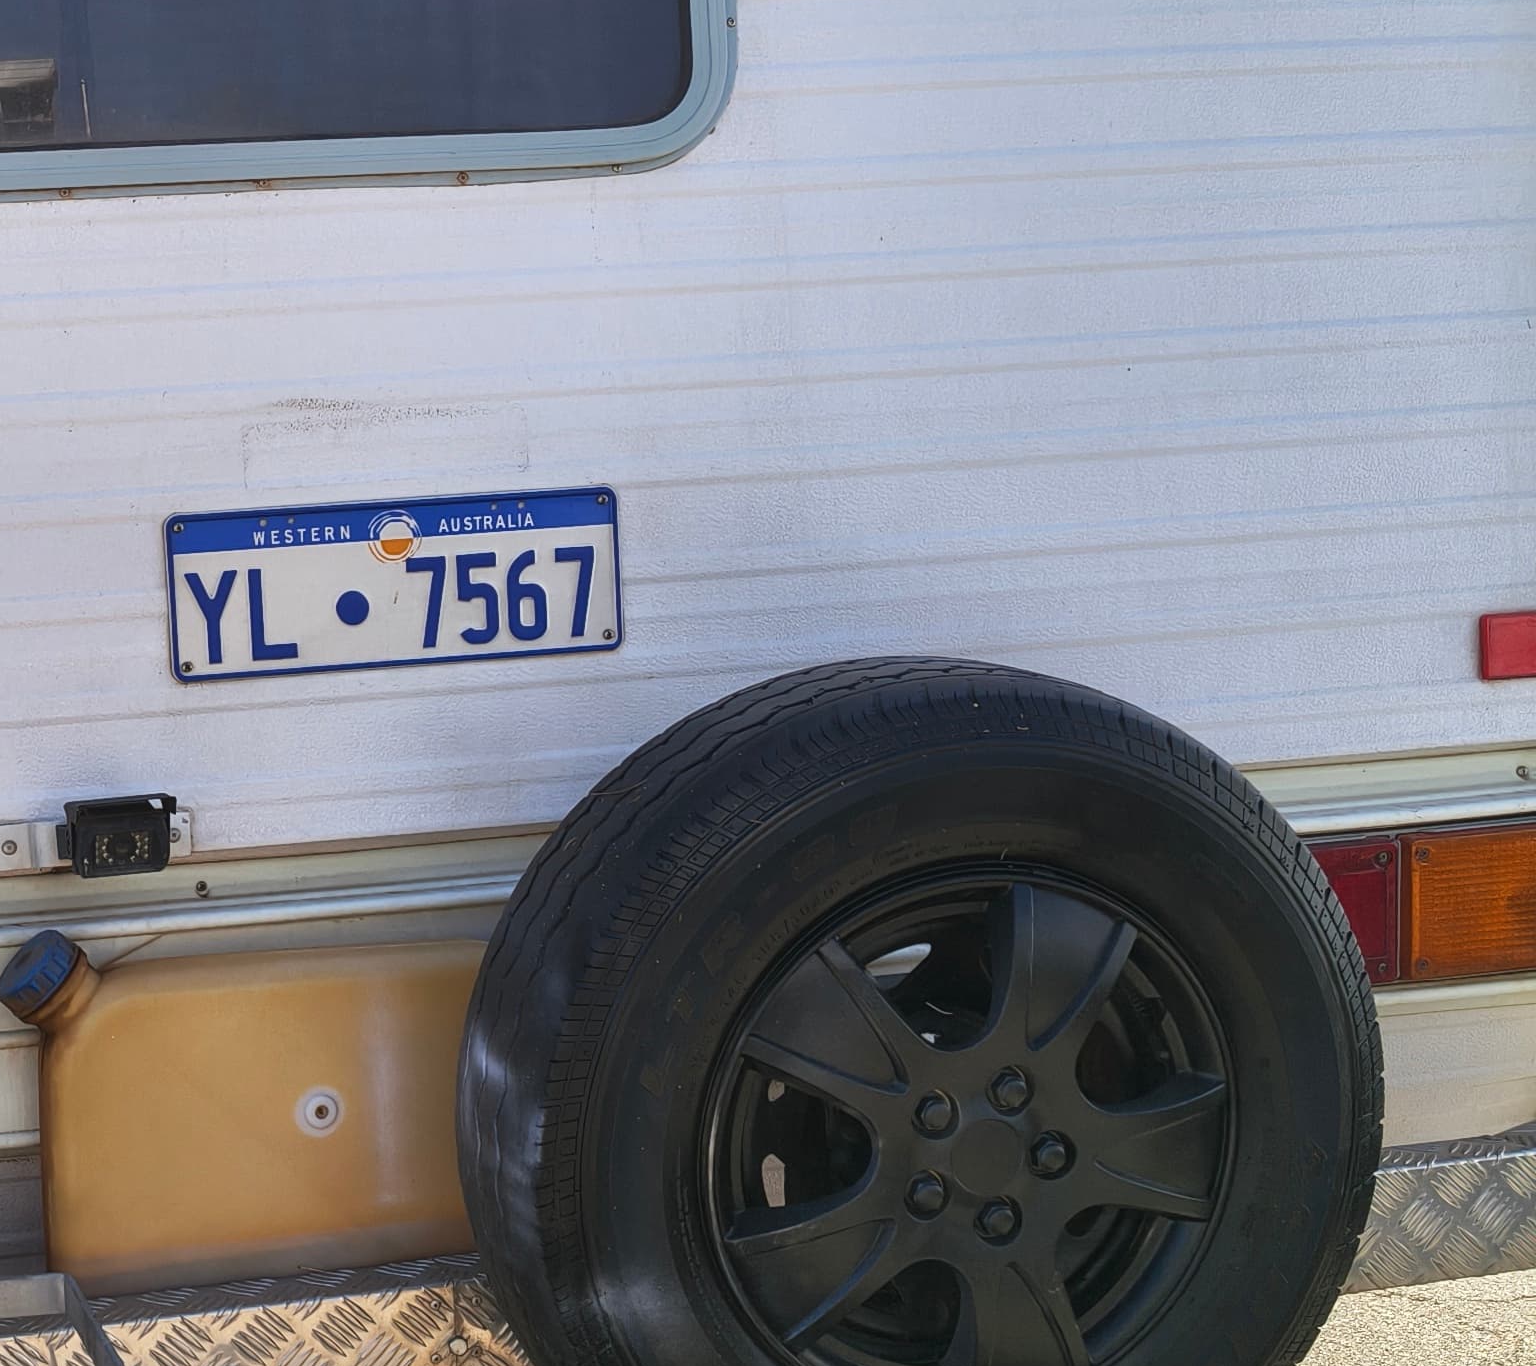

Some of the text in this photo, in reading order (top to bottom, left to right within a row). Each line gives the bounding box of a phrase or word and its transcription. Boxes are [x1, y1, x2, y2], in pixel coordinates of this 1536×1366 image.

[253, 513, 535, 546] WESTERN AUSTRALIA
[184, 545, 595, 665] YL 7567
